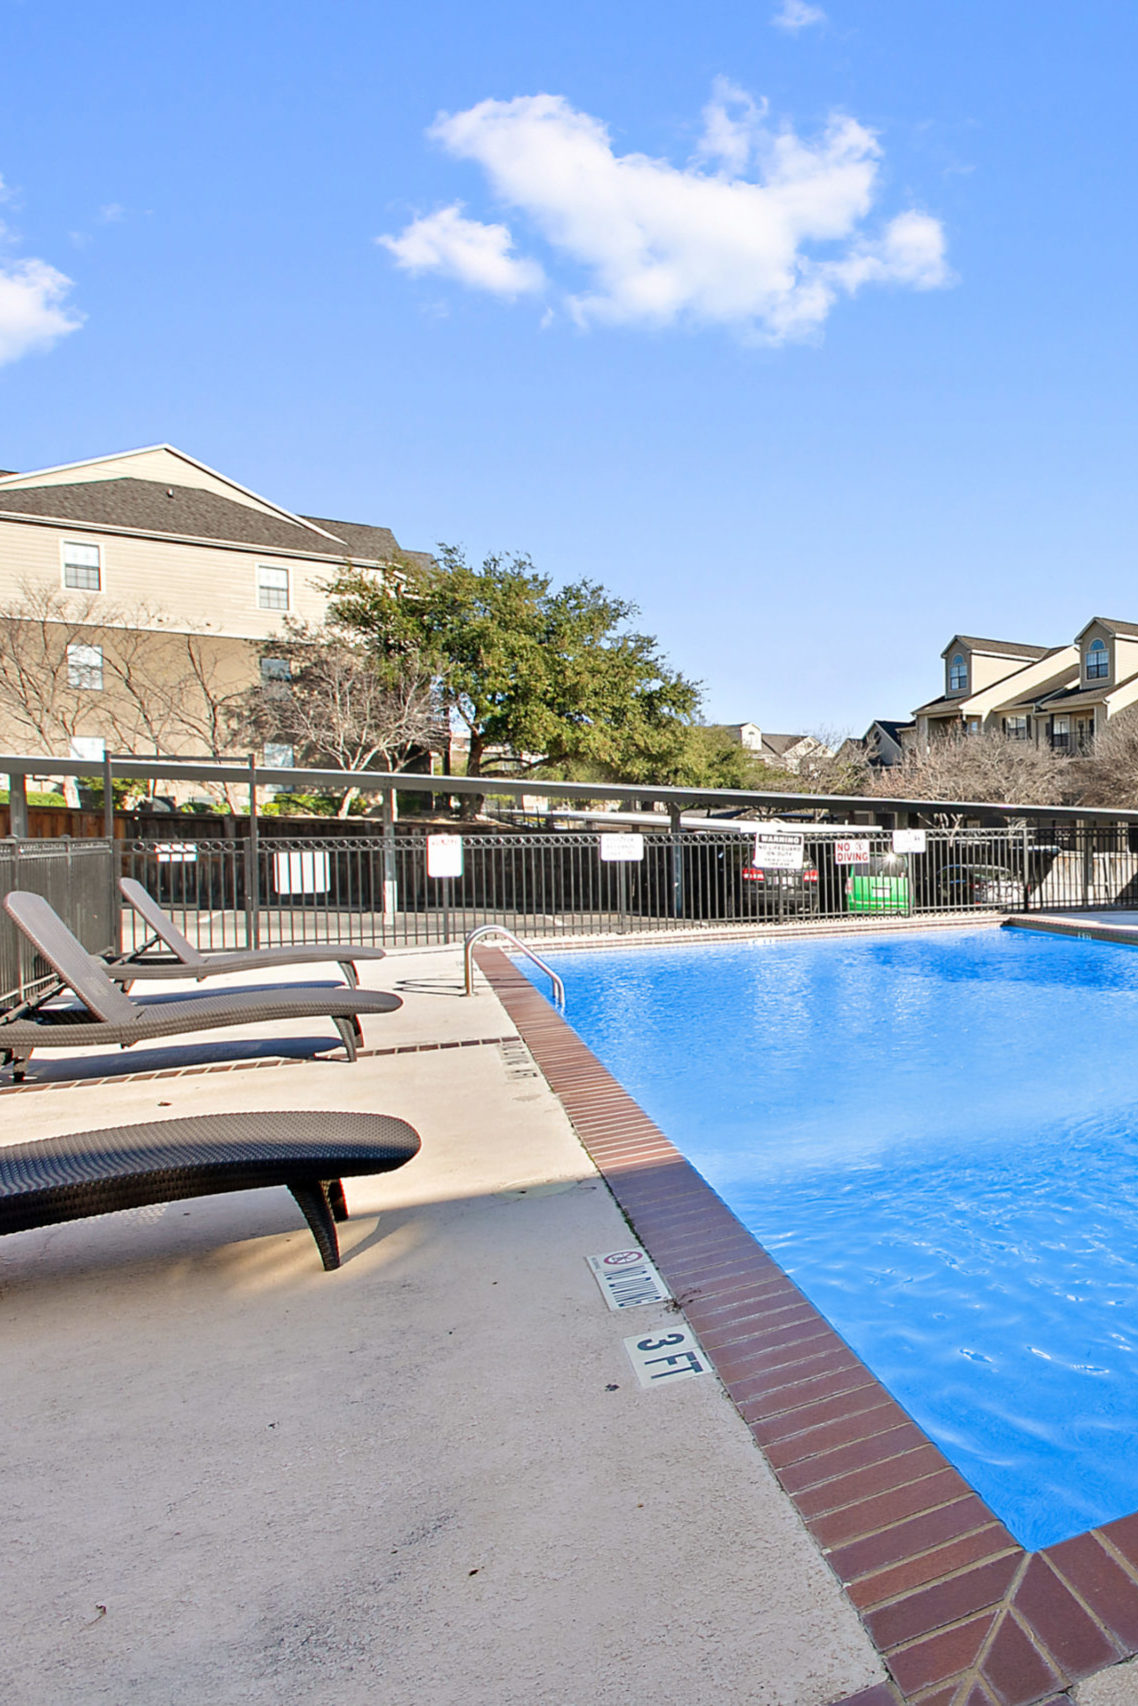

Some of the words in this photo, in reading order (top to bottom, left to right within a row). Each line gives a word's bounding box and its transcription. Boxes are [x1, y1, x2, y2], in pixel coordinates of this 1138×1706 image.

[761, 835, 800, 844] WARNING
[838, 842, 850, 851] NO
[838, 852, 869, 862] DIVING
[604, 1265, 650, 1280] NO
[609, 1276, 662, 1307] DIVING
[637, 1333, 685, 1351] 3
[644, 1351, 704, 1379] FT
